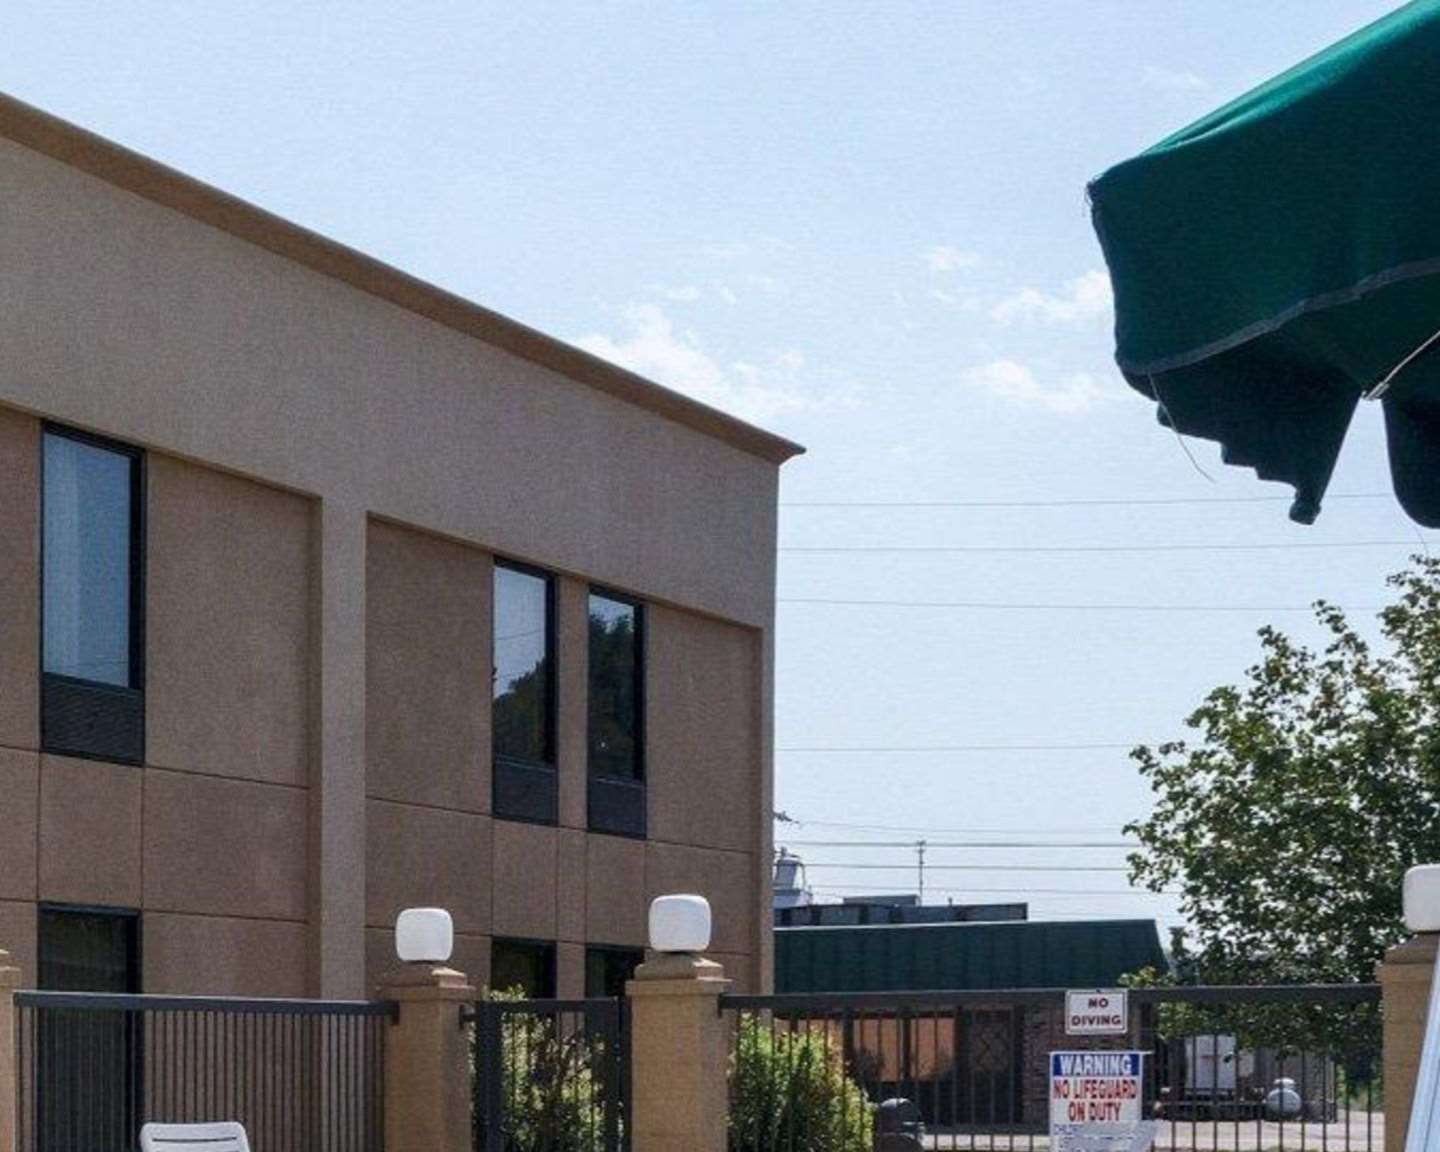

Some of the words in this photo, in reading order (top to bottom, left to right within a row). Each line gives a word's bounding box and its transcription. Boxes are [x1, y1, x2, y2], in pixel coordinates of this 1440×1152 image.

[1088, 998, 1109, 1009] NO
[1071, 1015, 1122, 1026] DIVING
[1060, 1055, 1133, 1076] WARNING
[1054, 1079, 1070, 1099] NO
[1073, 1079, 1137, 1099] LIFEGUARD
[1068, 1101, 1086, 1121] ON
[1089, 1101, 1122, 1121] DUTY
